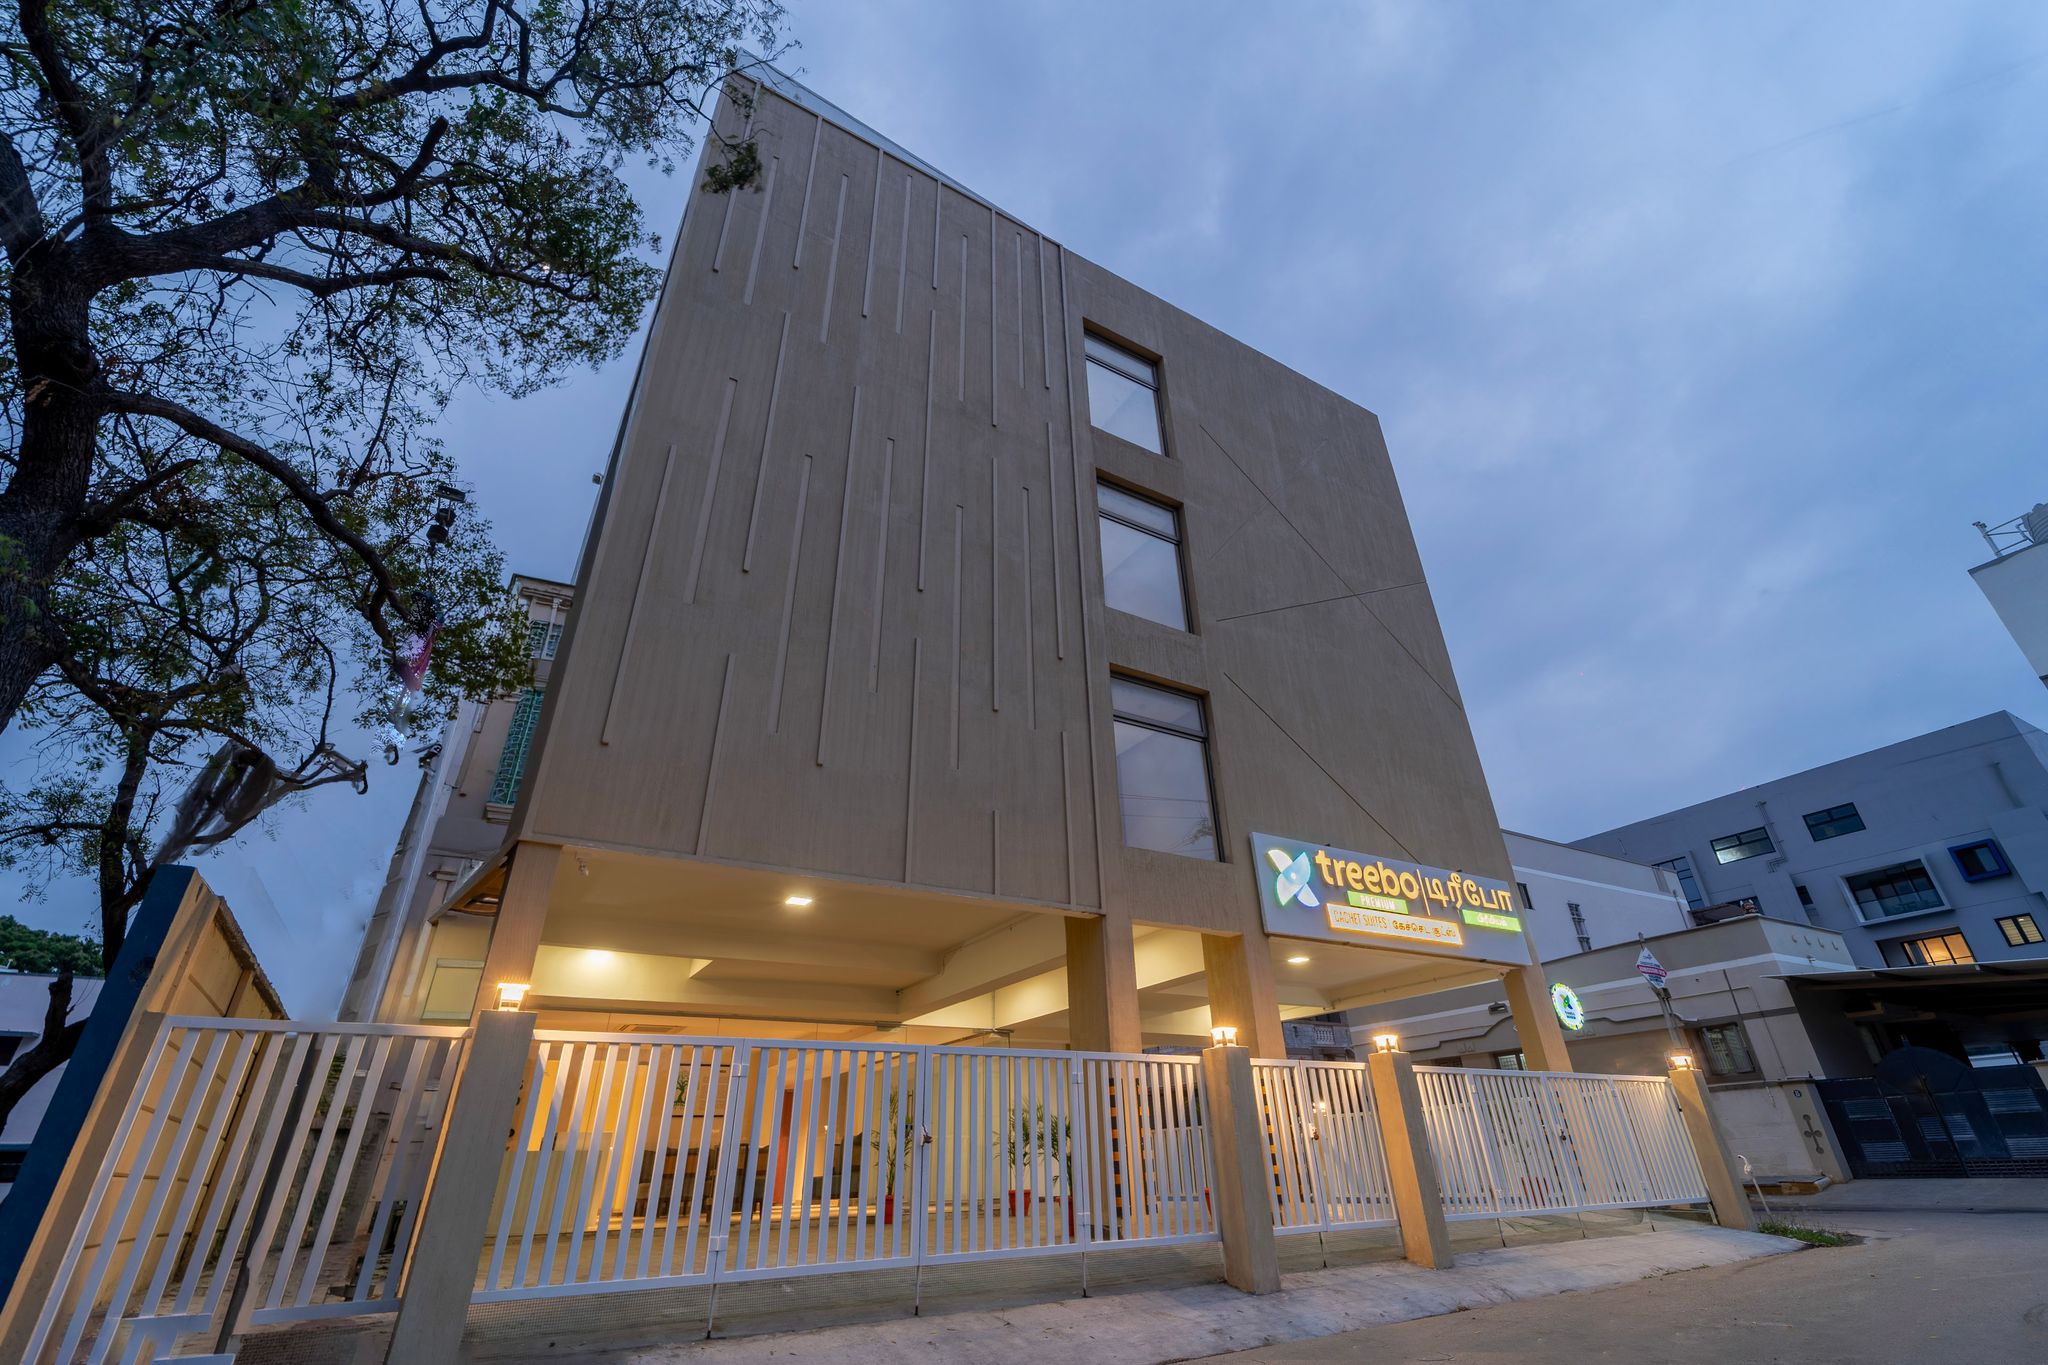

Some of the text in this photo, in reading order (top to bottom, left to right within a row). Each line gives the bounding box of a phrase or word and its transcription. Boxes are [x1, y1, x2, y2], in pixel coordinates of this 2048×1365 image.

[1315, 850, 1419, 899] treebo
[1360, 894, 1396, 911] PREMIUM
[1333, 910, 1388, 929] CACHET SUITES
